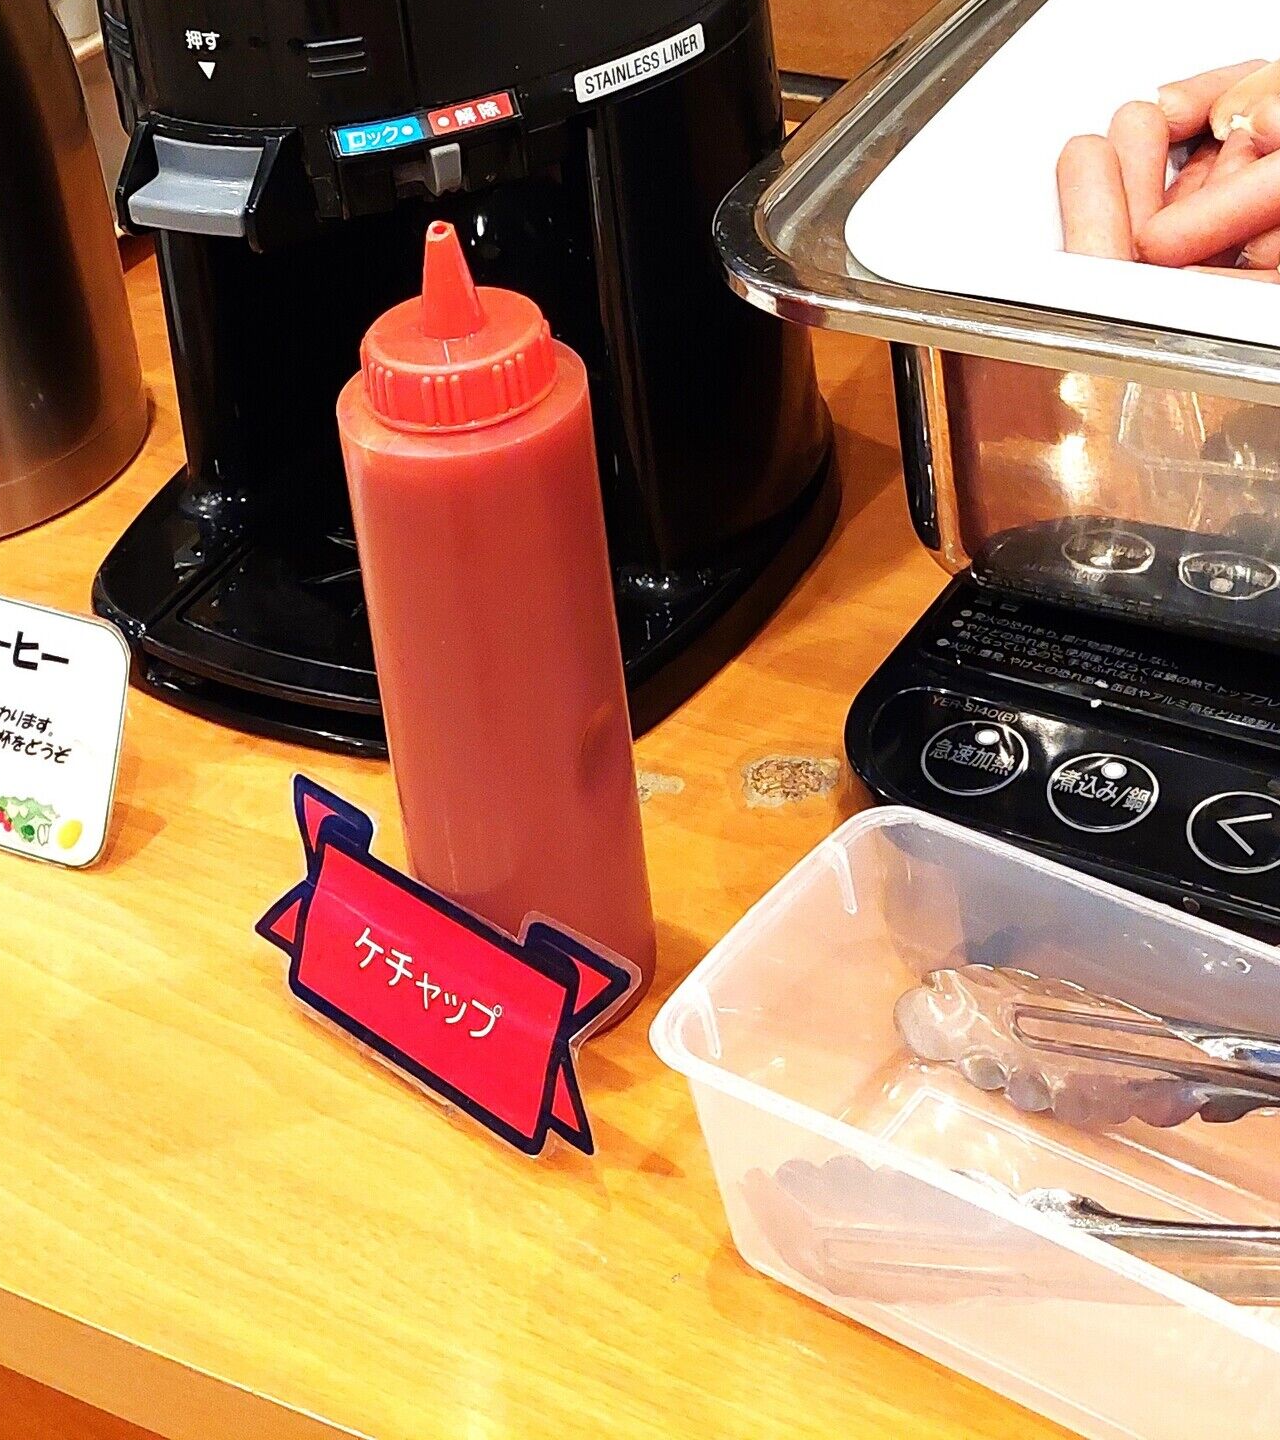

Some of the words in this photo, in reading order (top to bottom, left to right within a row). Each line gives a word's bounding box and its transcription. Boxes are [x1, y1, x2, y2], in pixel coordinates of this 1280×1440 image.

[185, 29, 220, 51] 押す
[584, 51, 660, 95] STAINLESS
[663, 33, 699, 64] LINER
[454, 100, 502, 126] 解除
[346, 125, 399, 150] ロック
[929, 738, 1015, 777] 急速加熱
[1053, 769, 1152, 814] 煮込み/鍋
[353, 926, 504, 1039] ケチャップ
